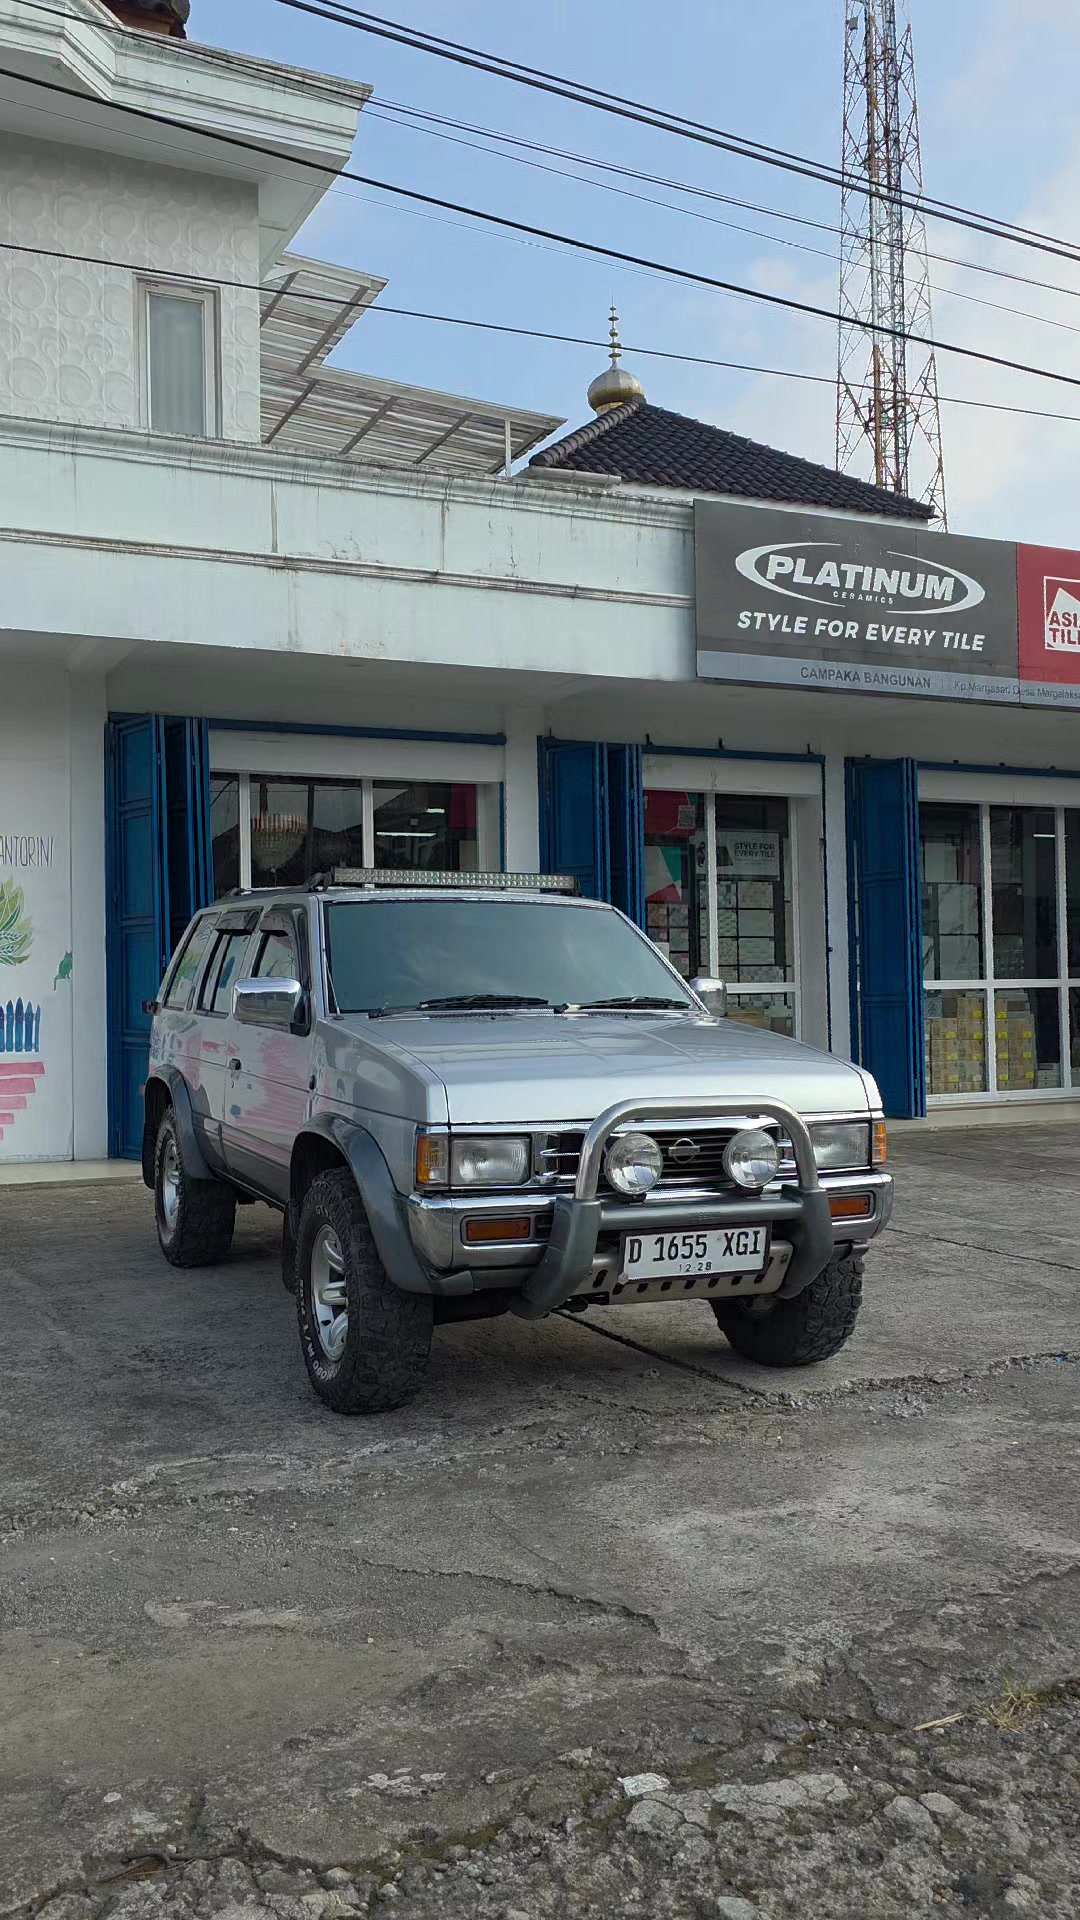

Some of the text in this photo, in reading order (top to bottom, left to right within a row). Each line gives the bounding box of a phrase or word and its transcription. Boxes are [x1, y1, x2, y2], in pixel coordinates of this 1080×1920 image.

[766, 554, 955, 601] PLATINUM
[833, 590, 894, 605] CERAMICS
[1048, 610, 1080, 628] ASI
[737, 611, 986, 651] STYLE FOR EVERY TILE
[800, 666, 931, 689] CAMPAKA BANGUNAN
[734, 842, 758, 850] STYLE
[628, 1230, 761, 1263] D 1655 XGI
